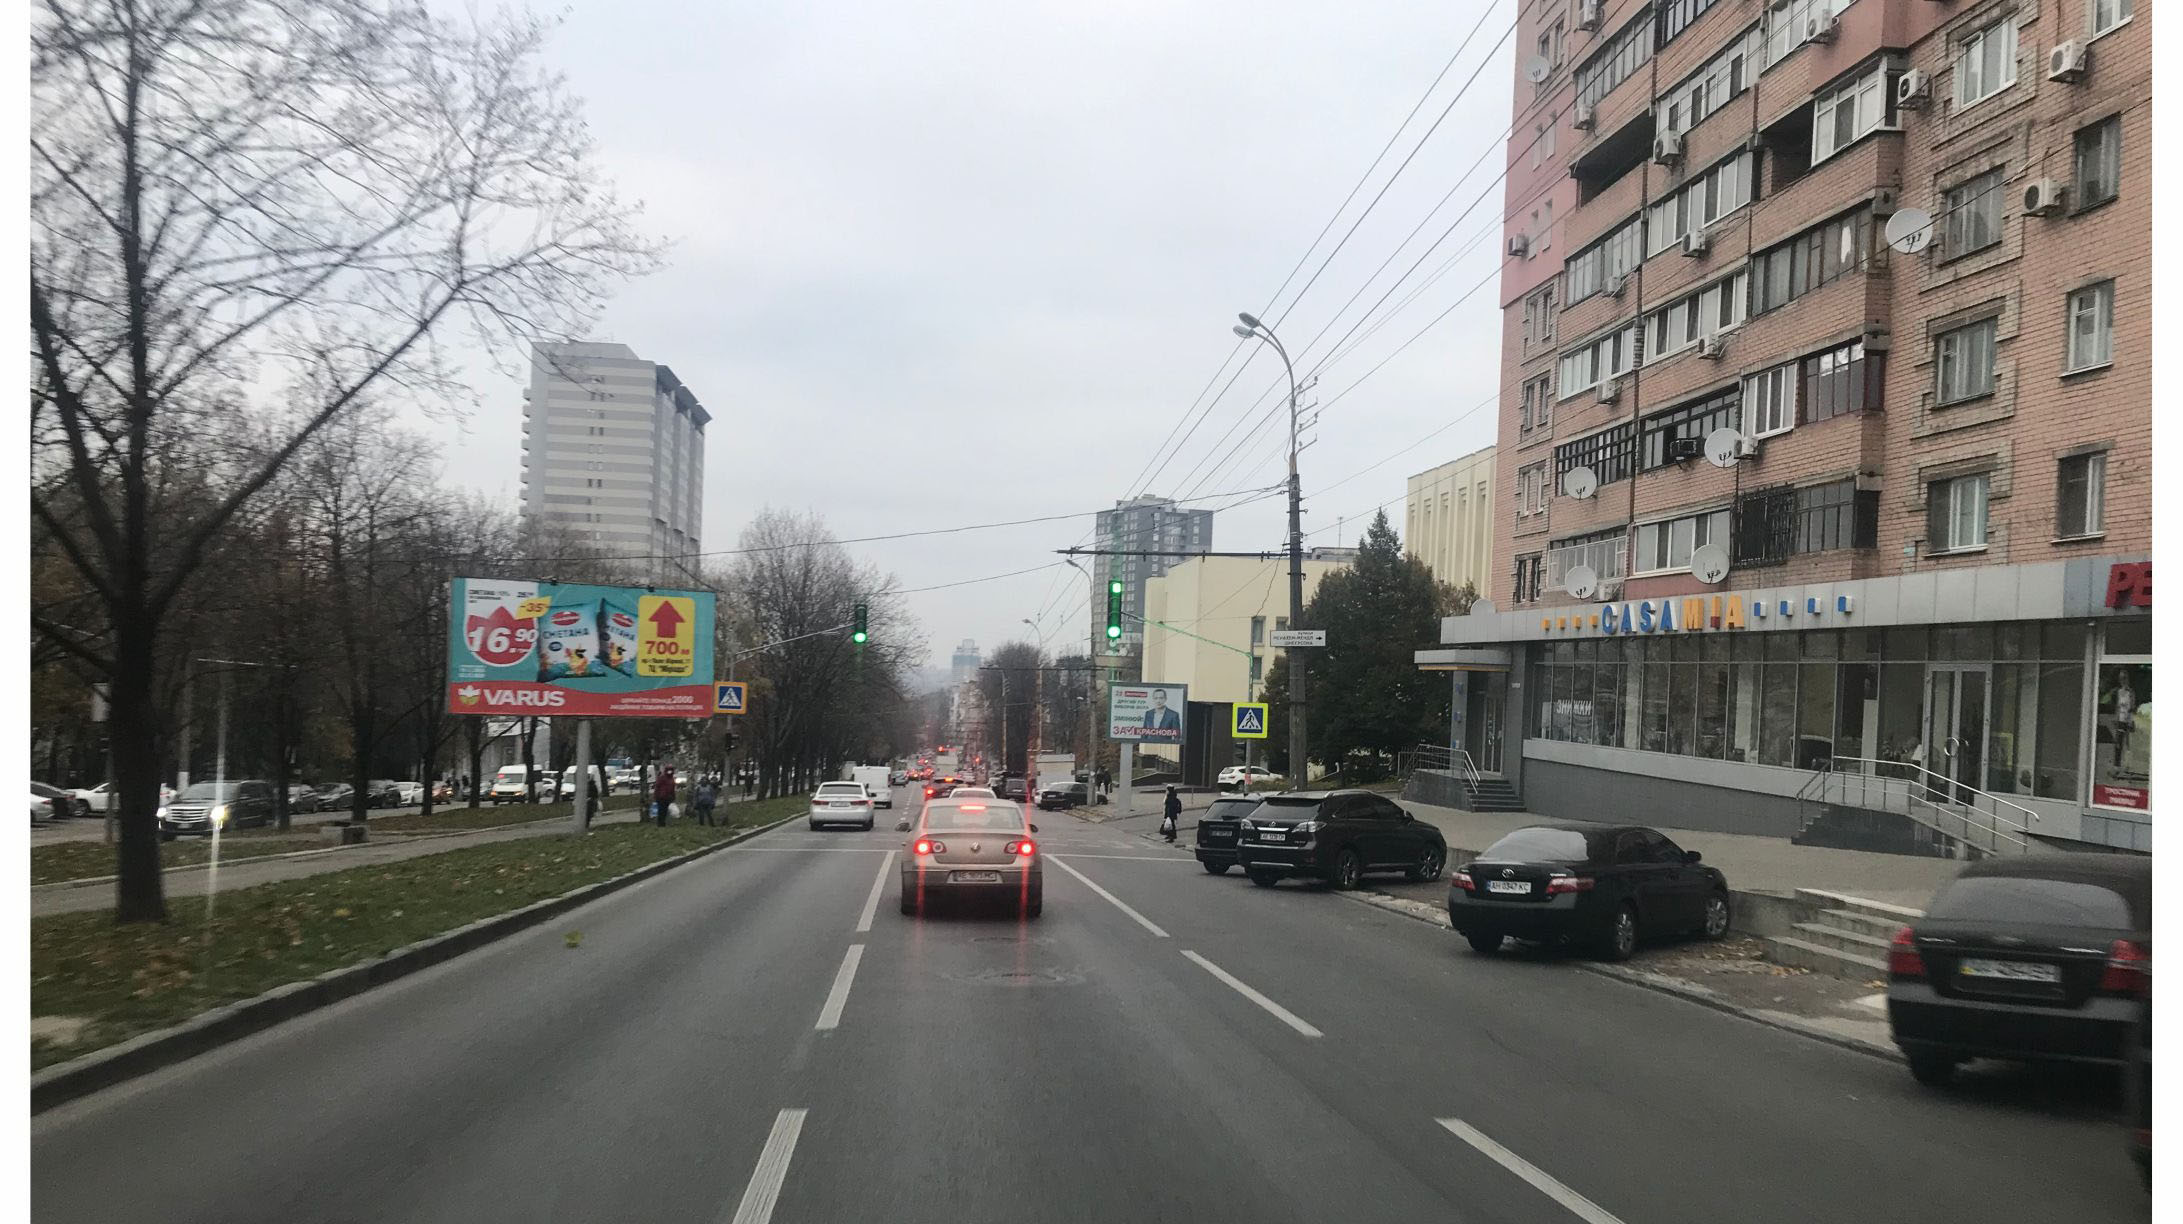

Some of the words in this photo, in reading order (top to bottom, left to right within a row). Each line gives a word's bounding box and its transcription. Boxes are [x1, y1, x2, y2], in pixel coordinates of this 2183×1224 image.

[645, 640, 679, 655] 700
[482, 688, 566, 707] VARUS
[1136, 728, 1178, 737] КРАСНОВА
